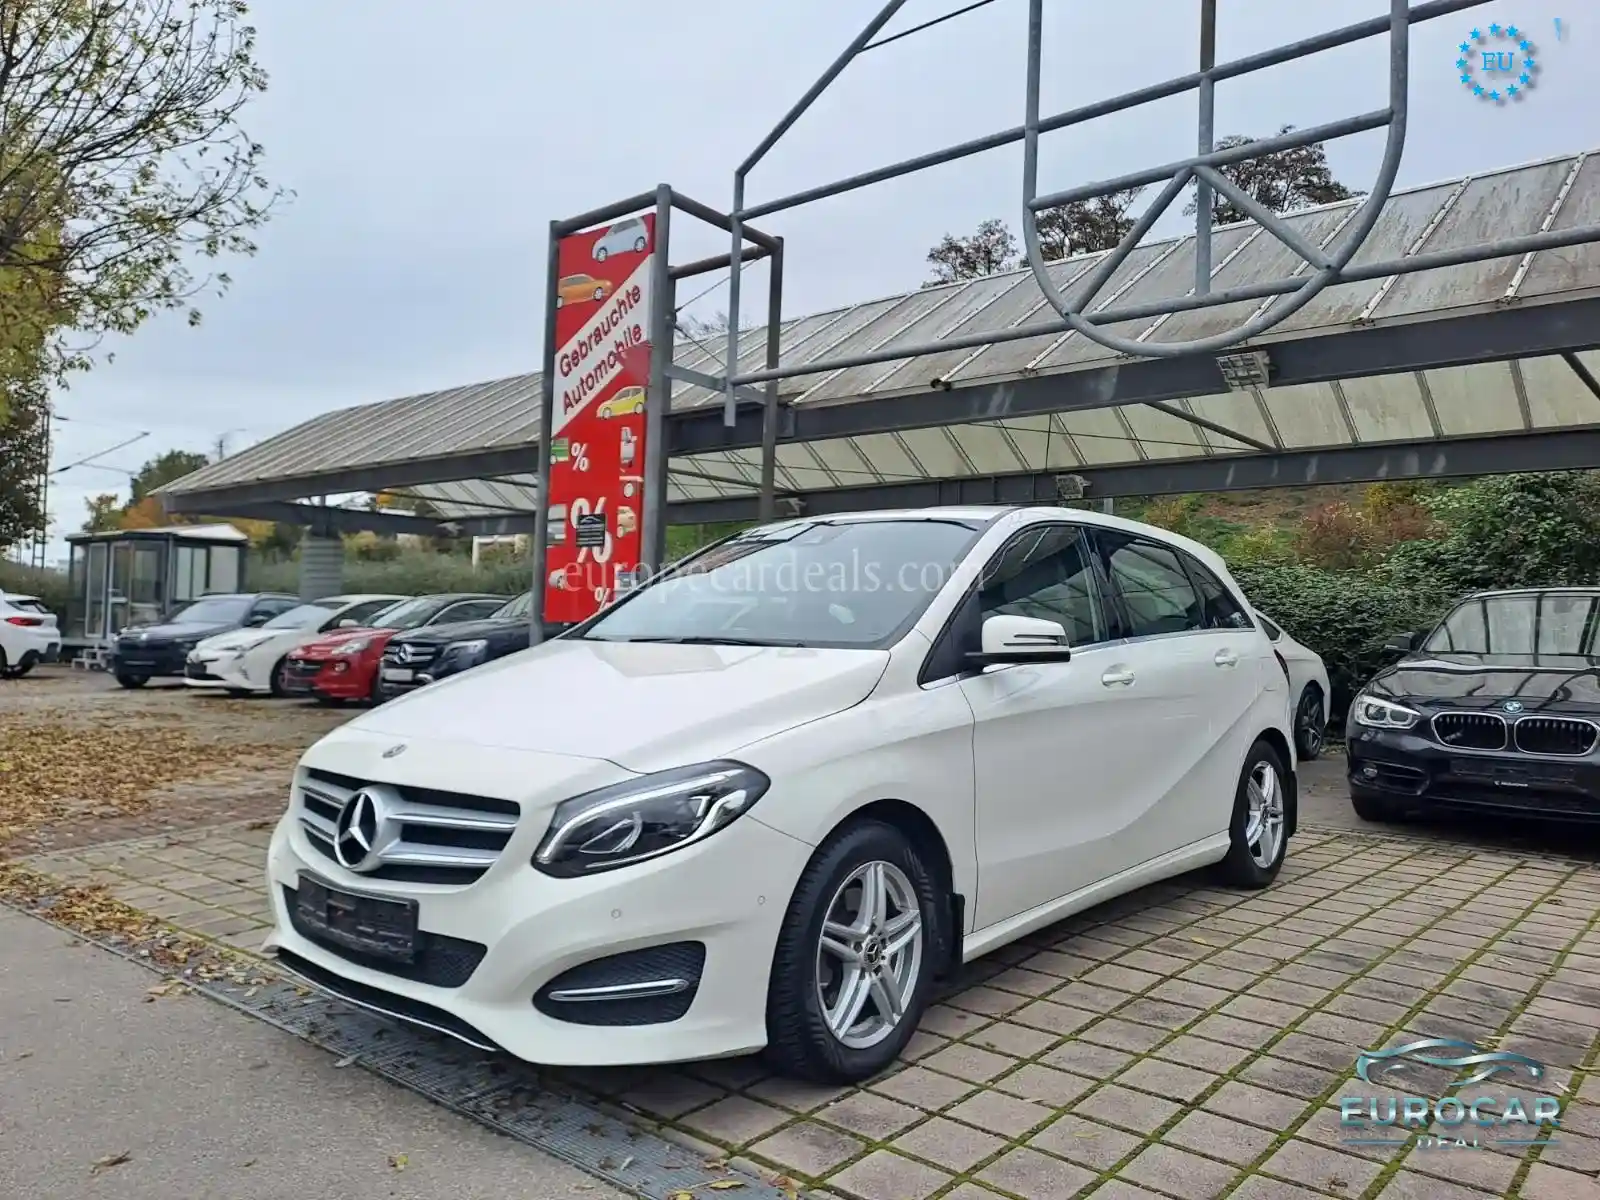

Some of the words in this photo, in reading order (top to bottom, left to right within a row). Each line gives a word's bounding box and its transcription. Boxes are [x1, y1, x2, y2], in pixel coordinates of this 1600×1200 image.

[560, 285, 641, 377] Gebrauchte
[563, 324, 642, 415] Automobile
[571, 442, 589, 472] %
